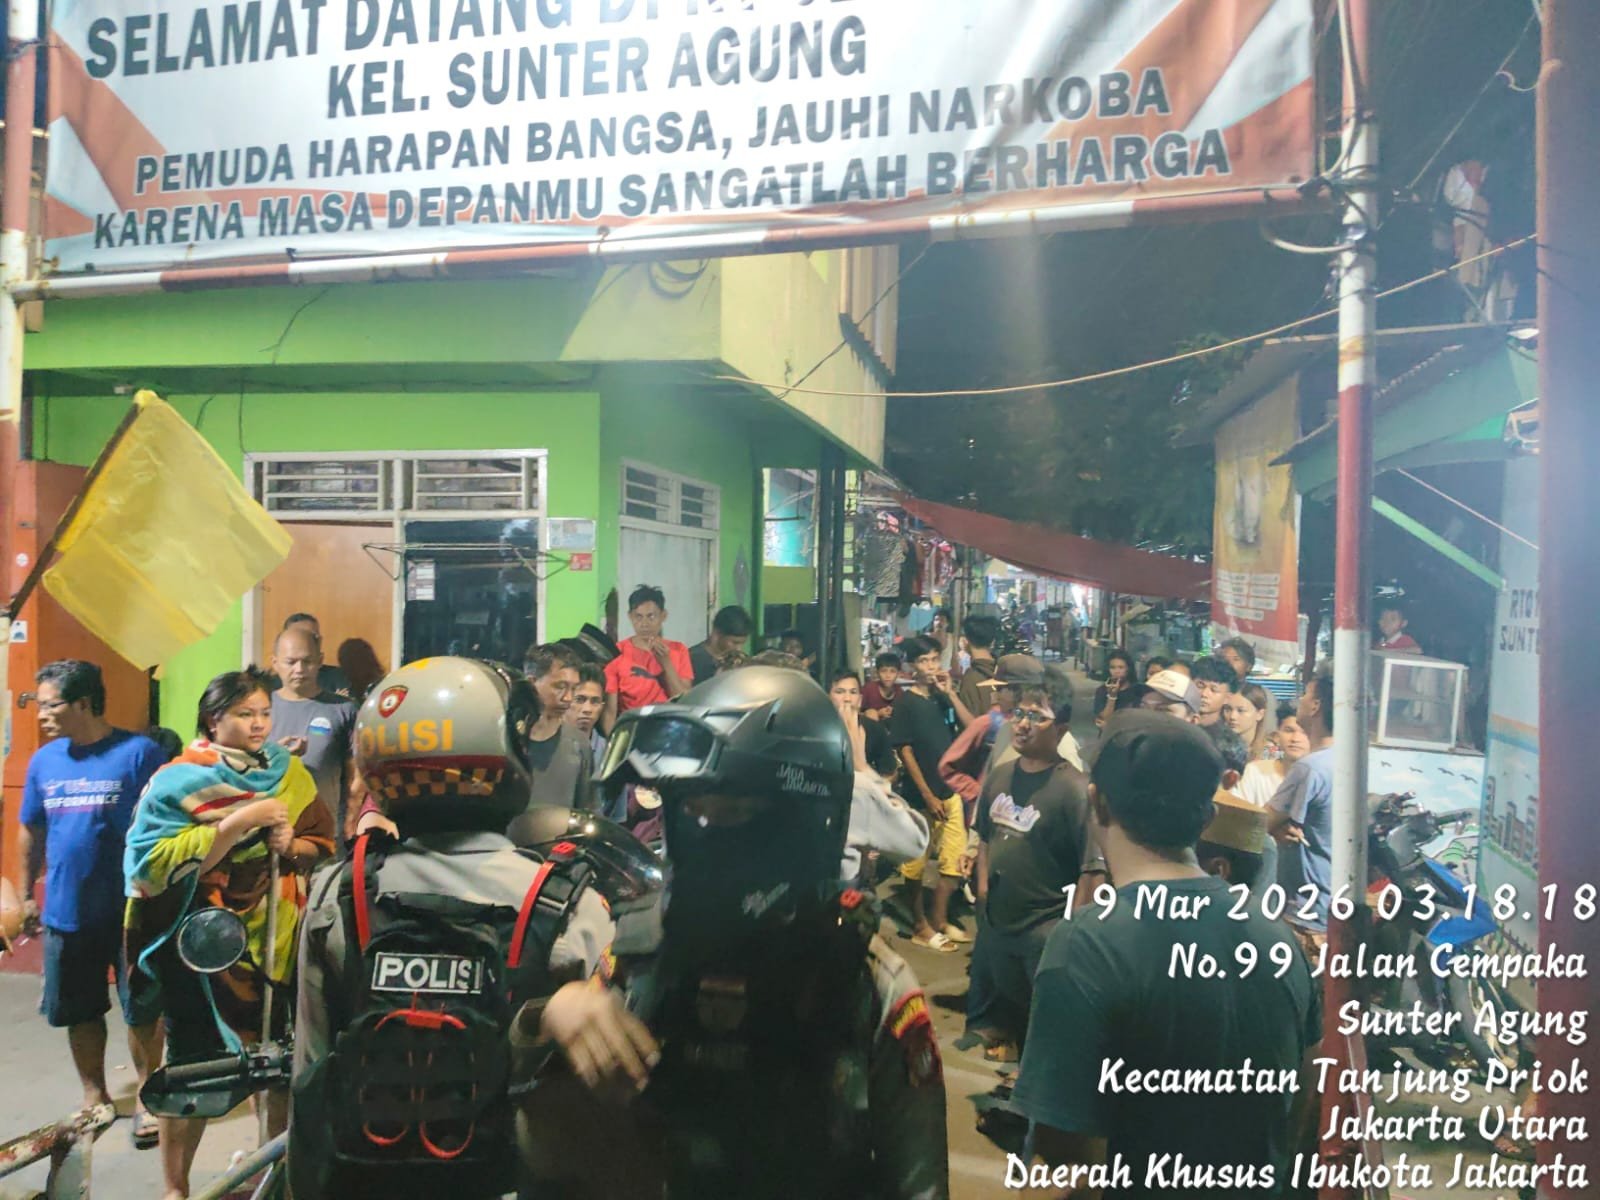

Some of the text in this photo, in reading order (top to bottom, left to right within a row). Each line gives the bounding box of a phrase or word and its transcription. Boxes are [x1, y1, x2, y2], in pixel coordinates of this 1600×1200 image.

[86, 0, 326, 79] SELAMAT
[328, 15, 866, 118] KEL. SUNTER AGUNG
[136, 69, 1170, 194] PEMUDA HARAPAN BANGSA, JAUHI NARKOBA
[94, 128, 1230, 248] KARENA MASA DEPANMU SANGATLAH BERHARGA
[357, 719, 454, 758] OLISI
[378, 957, 481, 990] POLISI
